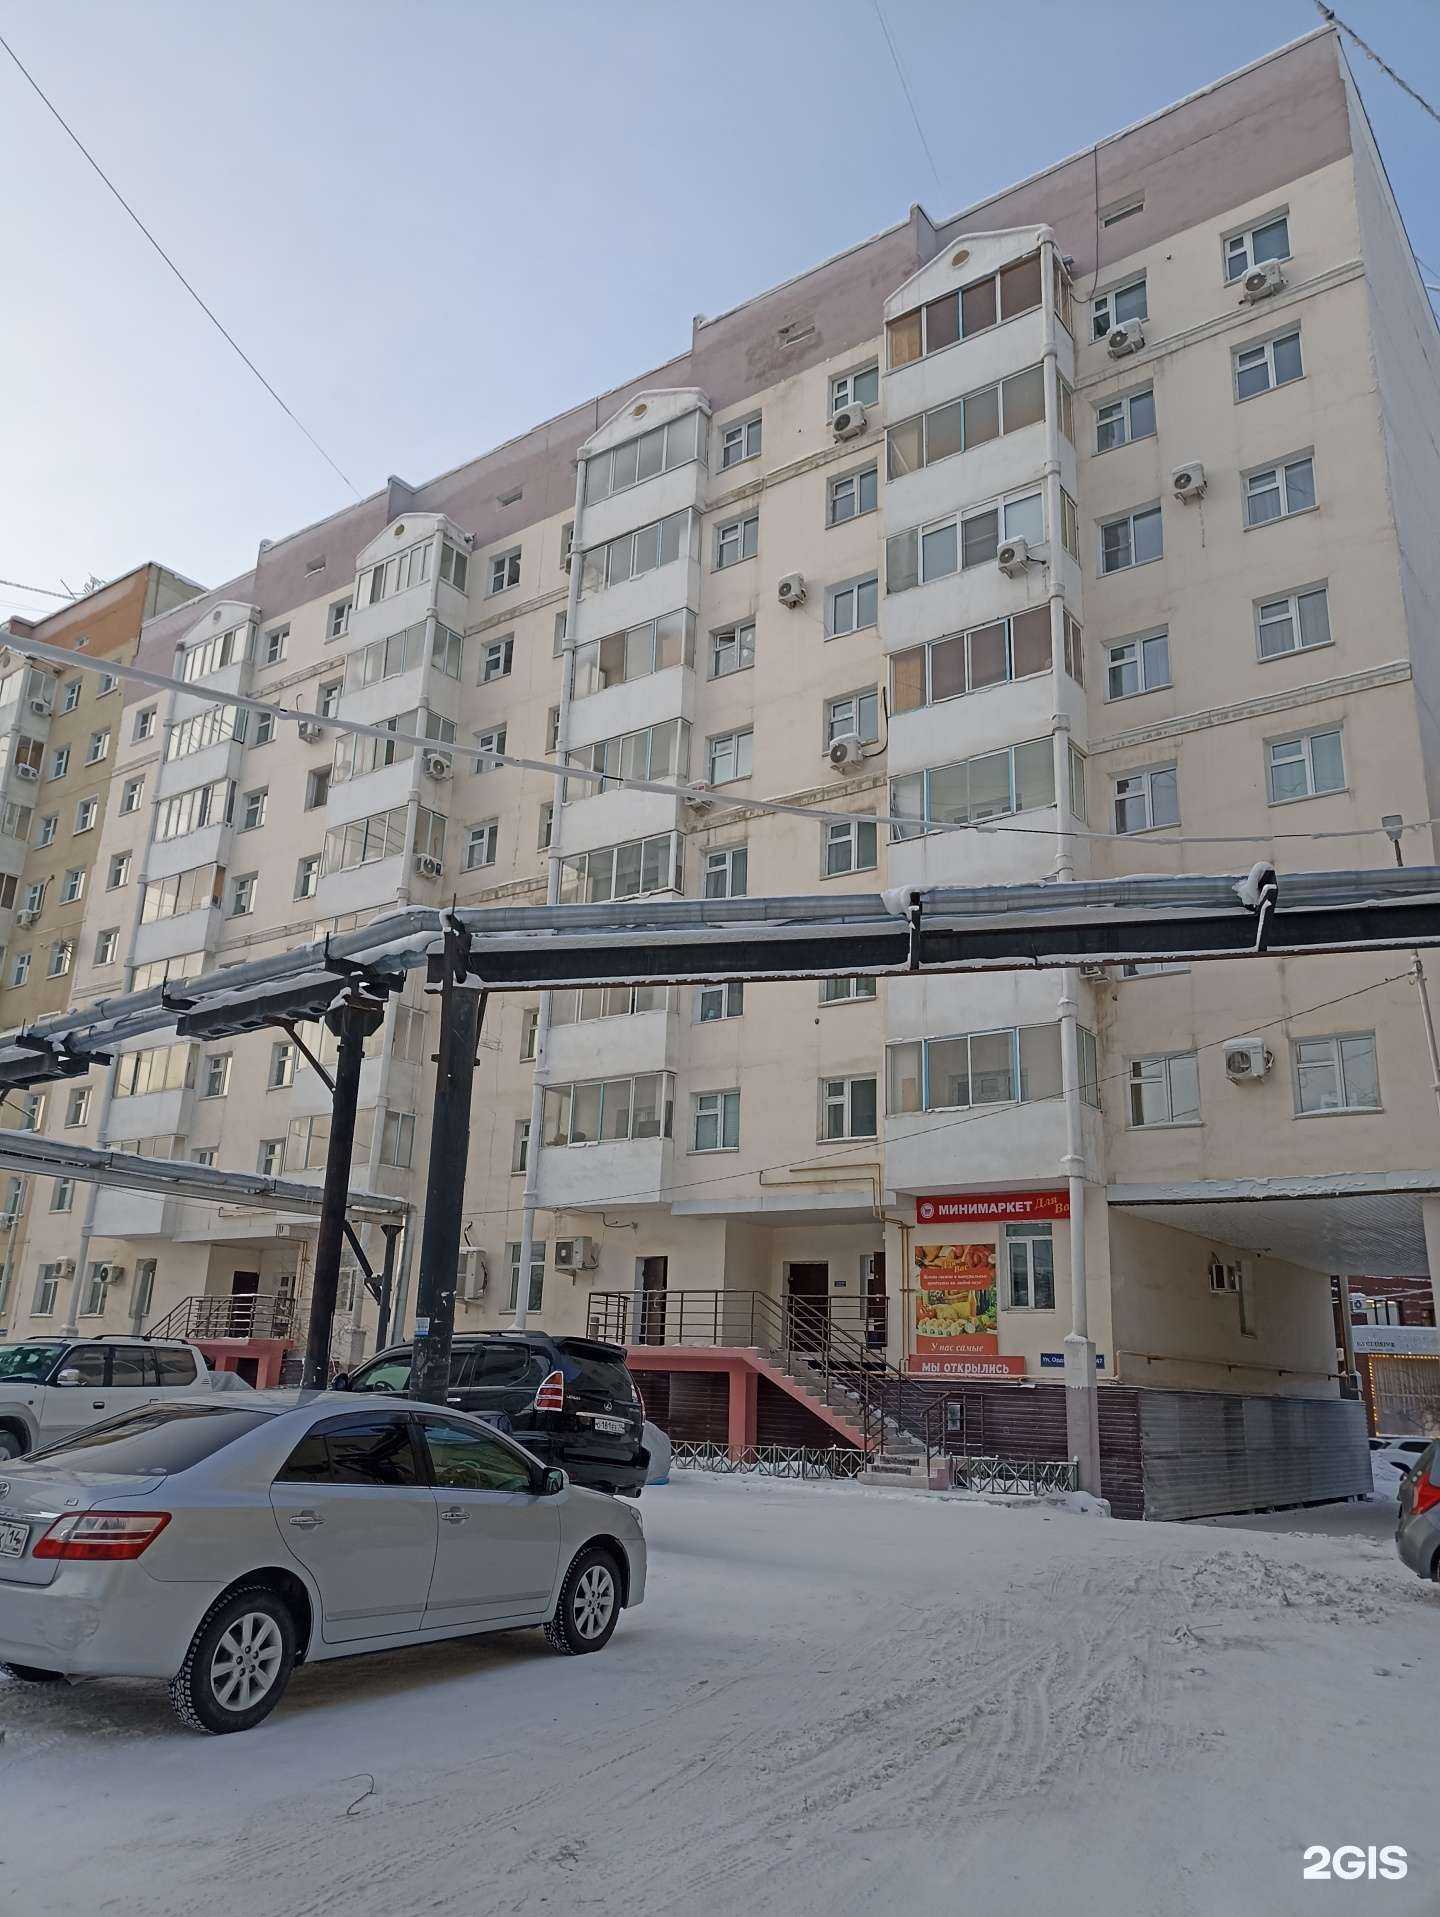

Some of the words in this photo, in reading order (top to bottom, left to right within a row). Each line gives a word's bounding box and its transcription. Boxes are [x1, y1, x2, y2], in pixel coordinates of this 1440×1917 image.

[939, 1201, 1032, 1215] МИНИМАРКЕТ
[1055, 1203, 1070, 1214] Ва
[929, 1343, 938, 1351] У
[939, 1344, 955, 1352] нас
[955, 1344, 984, 1352] самые
